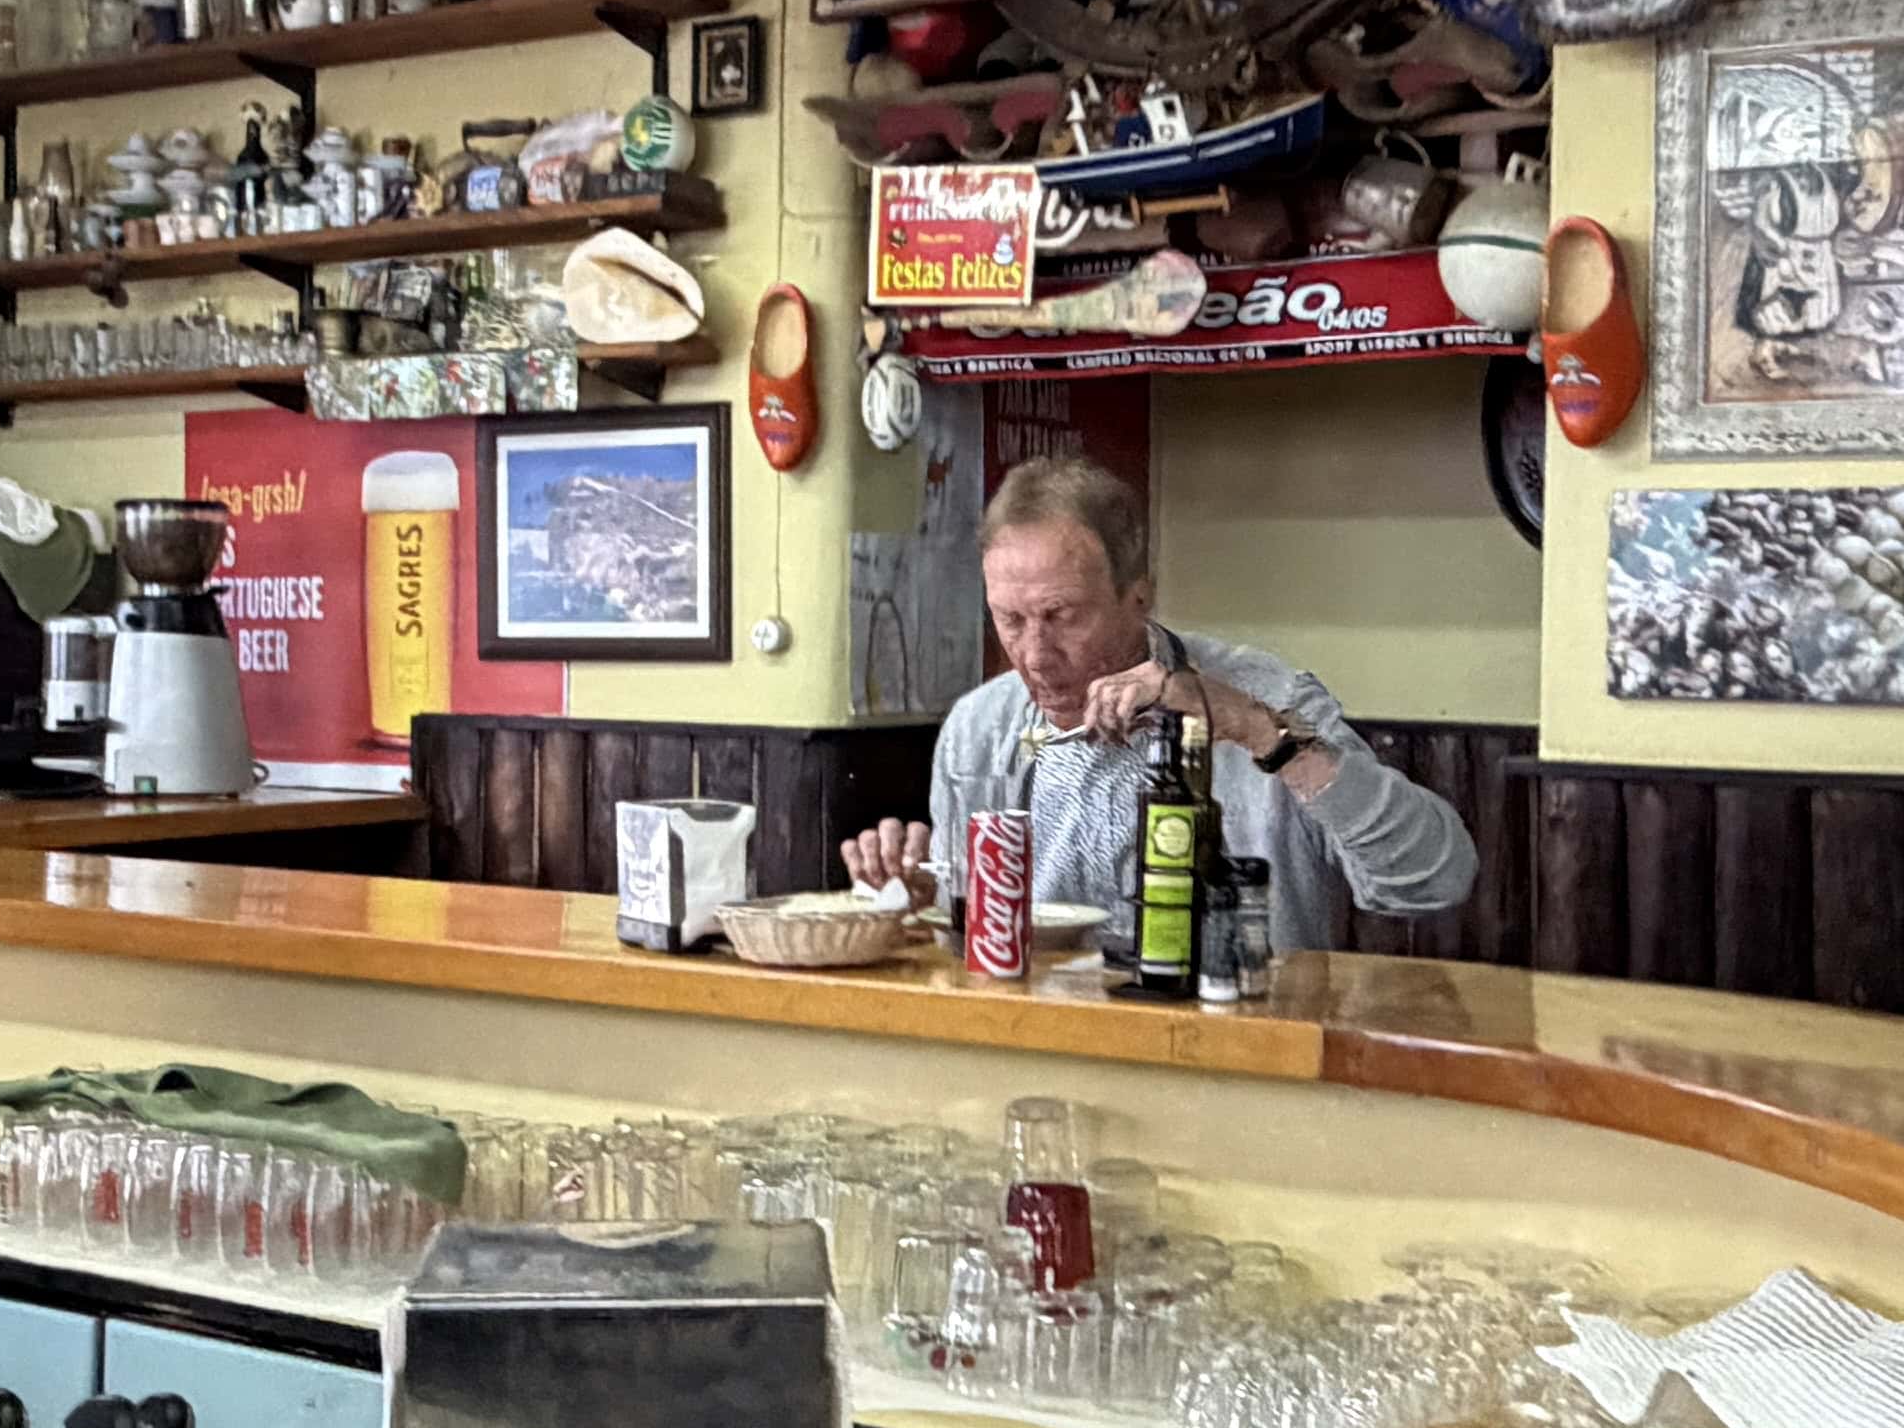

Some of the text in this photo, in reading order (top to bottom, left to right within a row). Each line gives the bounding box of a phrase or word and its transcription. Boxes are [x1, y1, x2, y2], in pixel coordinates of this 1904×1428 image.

[881, 252, 1023, 290] Festas Felizes
[1317, 305, 1389, 332] 04/05
[395, 523, 424, 638] SAGRES
[238, 628, 290, 672] BEER
